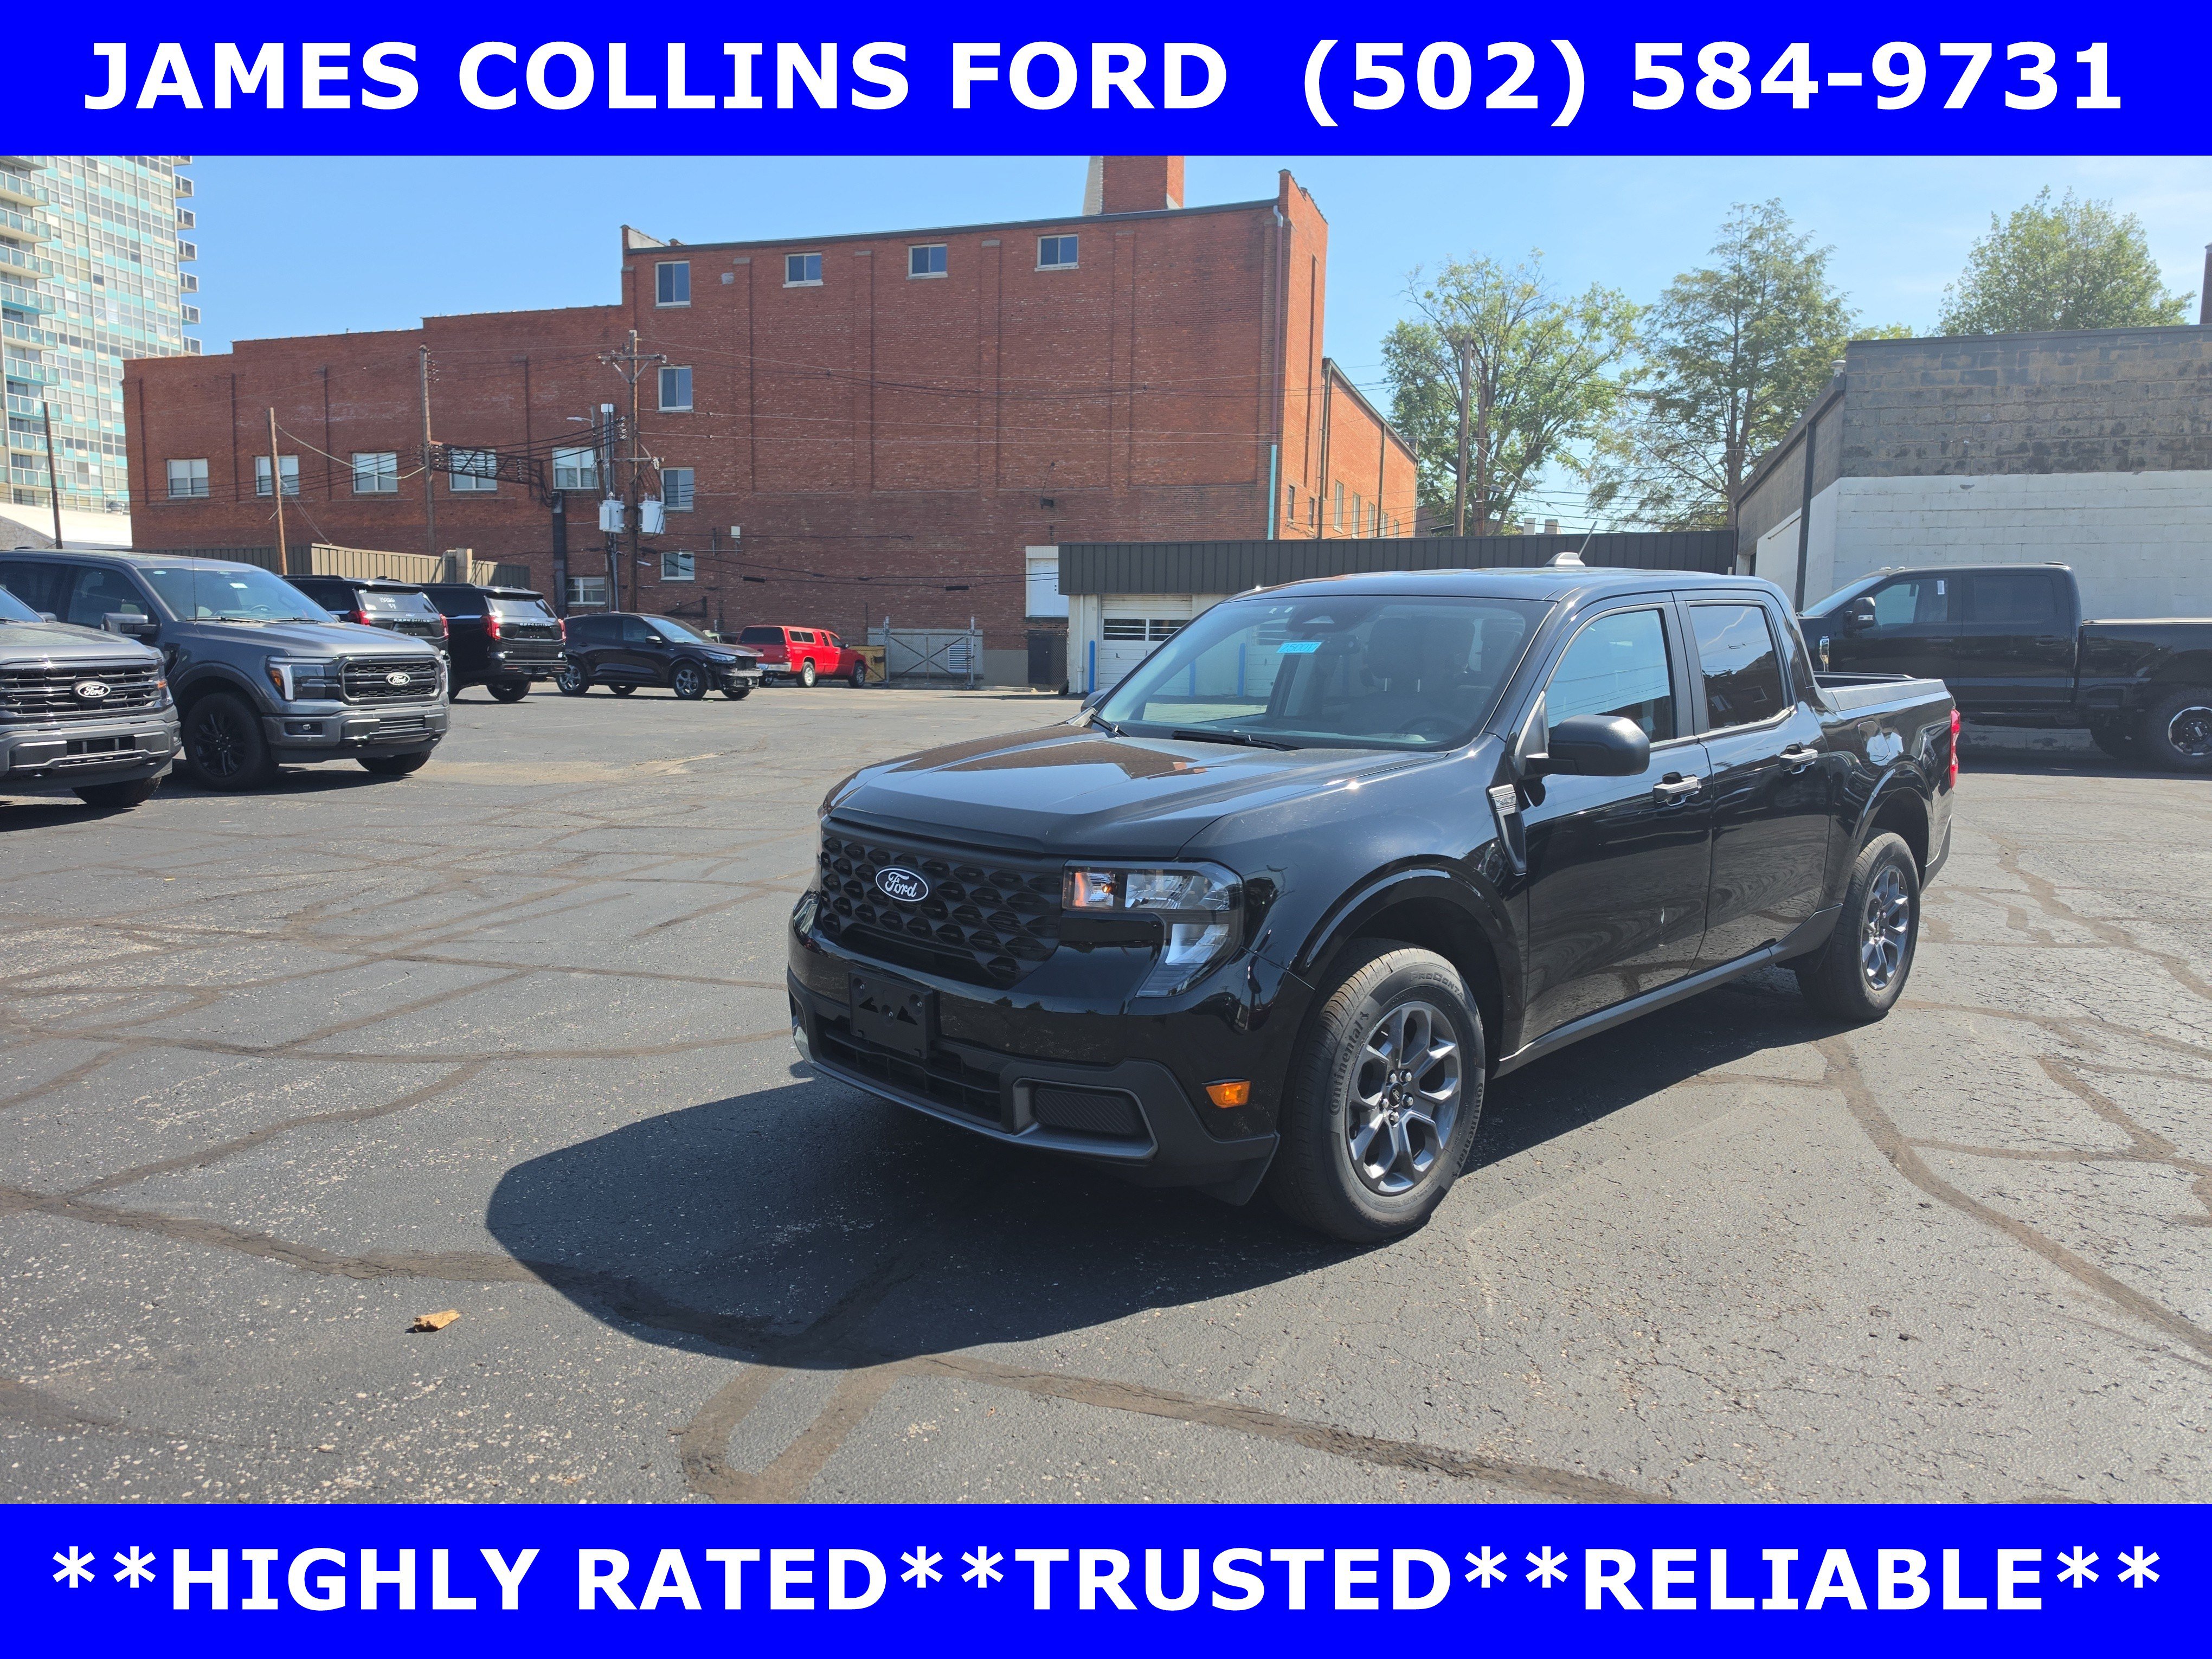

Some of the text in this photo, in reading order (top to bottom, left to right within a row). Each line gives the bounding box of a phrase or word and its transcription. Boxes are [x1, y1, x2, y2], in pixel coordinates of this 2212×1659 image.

[392, 675, 407, 684] Ford
[83, 686, 105, 696] Ford
[1496, 795, 1515, 807] XLT
[885, 872, 918, 897] Ford
[1330, 1020, 1362, 1116] Continental
